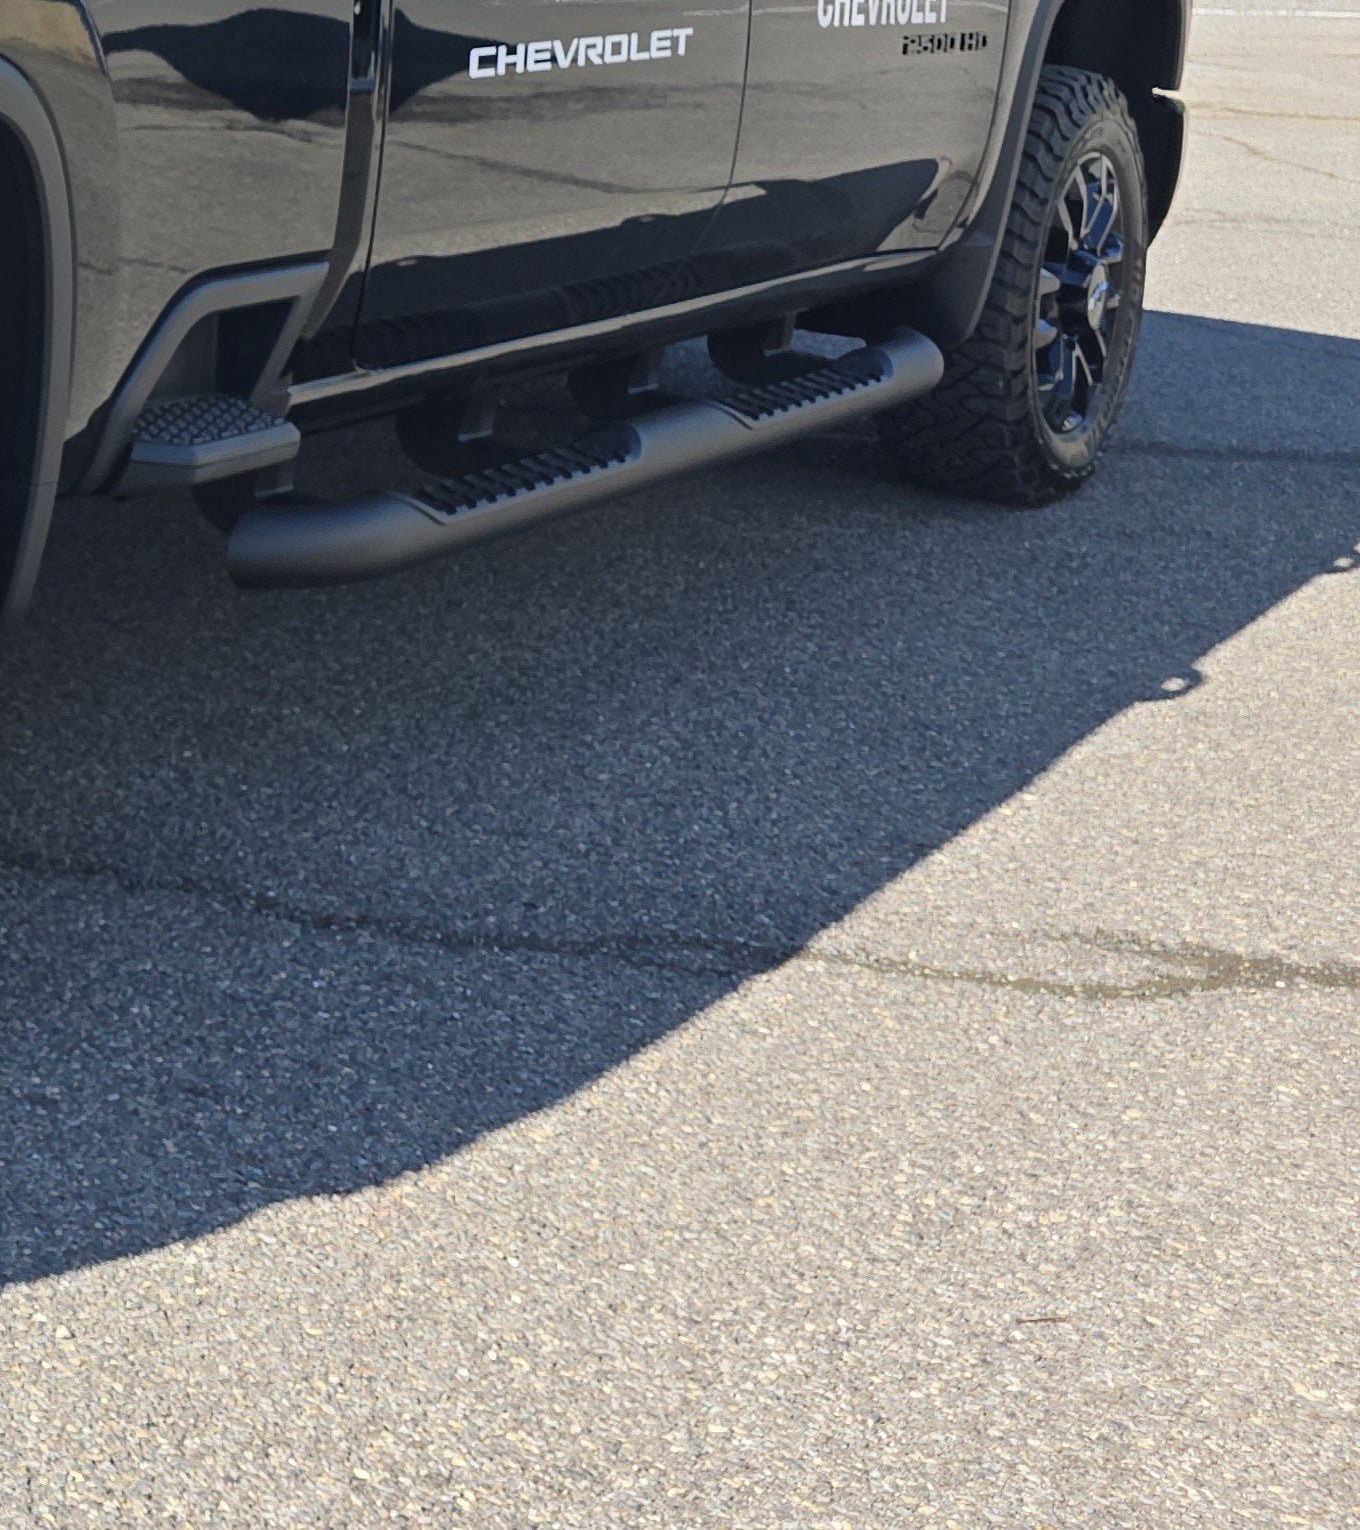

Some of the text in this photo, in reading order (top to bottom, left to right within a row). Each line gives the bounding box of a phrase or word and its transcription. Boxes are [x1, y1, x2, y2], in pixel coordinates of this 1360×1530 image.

[469, 26, 694, 80] CHEVROLET
[902, 31, 988, 55] 2500 HD
